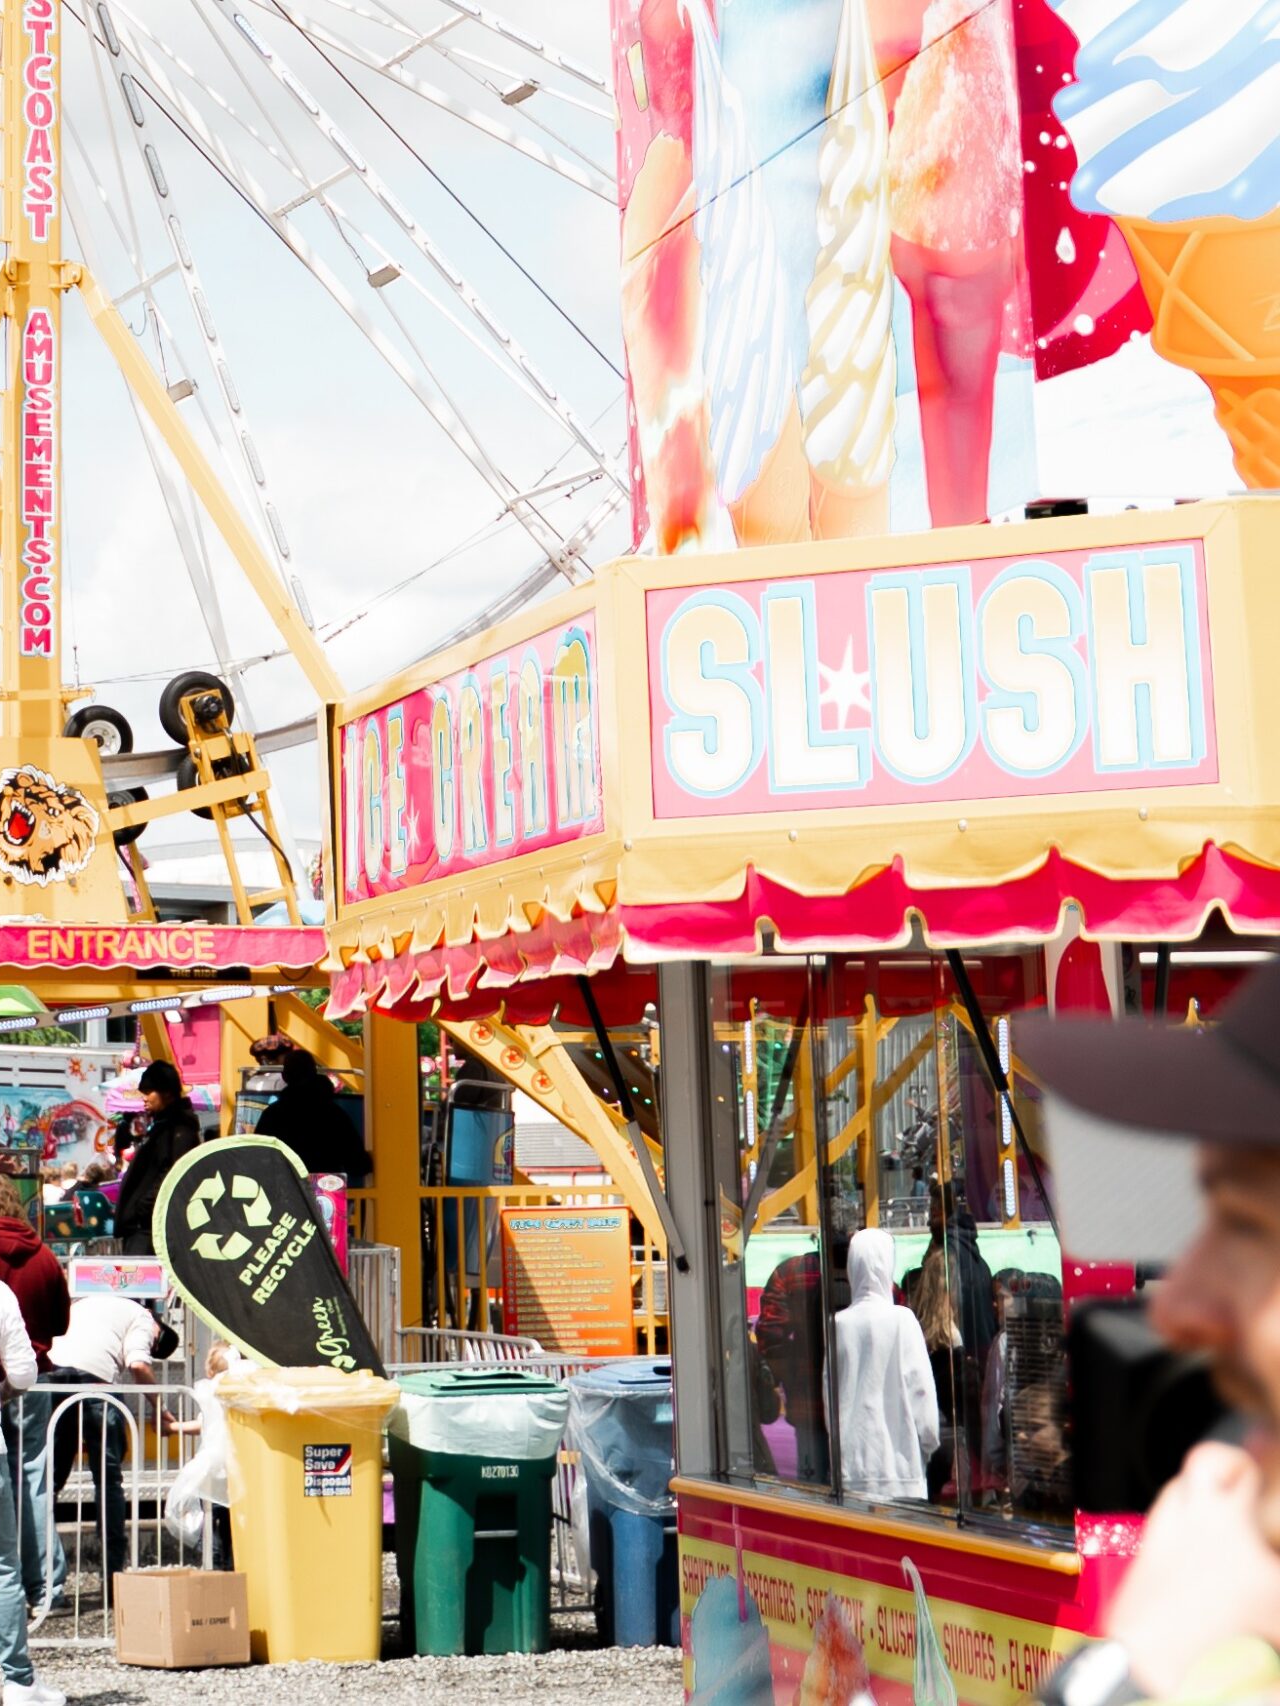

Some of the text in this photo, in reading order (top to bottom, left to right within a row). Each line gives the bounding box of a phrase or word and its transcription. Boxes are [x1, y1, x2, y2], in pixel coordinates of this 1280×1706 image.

[664, 548, 1197, 796] SLUSH
[345, 626, 597, 890] ICE CREAM
[27, 929, 217, 961] ENTRANCE
[238, 1212, 297, 1286] PLEASE
[251, 1219, 317, 1306] RECYCLE
[305, 1445, 343, 1461] Super
[305, 1458, 336, 1471] Save
[305, 1475, 351, 1489] Disposal
[877, 1604, 918, 1660] SLUSH
[942, 1622, 996, 1682] SUNDAES
